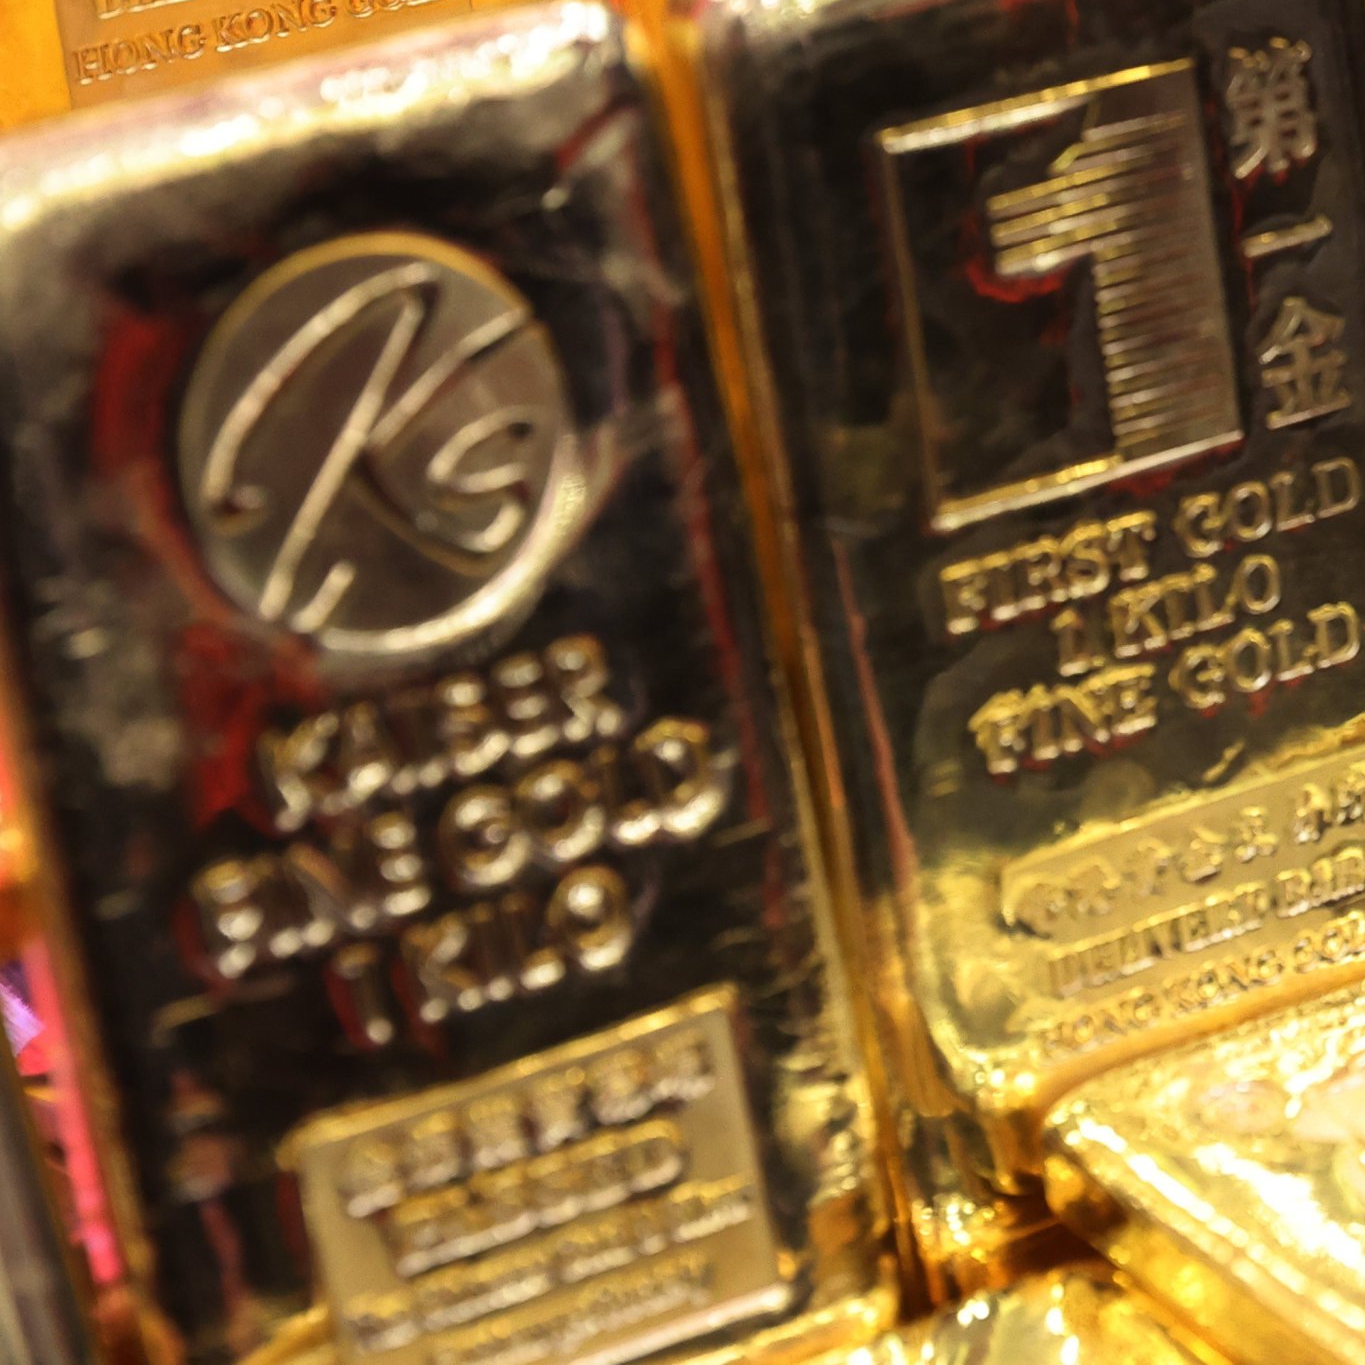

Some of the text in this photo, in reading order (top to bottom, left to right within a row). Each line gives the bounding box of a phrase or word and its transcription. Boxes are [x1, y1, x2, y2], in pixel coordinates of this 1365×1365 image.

[71, 21, 206, 86] HONG
[940, 457, 1362, 634] FIRST GOLD
[1051, 554, 1281, 678] 1 KILO
[258, 634, 622, 833] KAISER
[970, 601, 1362, 775] FINE GOLD
[193, 715, 735, 980] FINE GOLD
[332, 866, 637, 1045] 1 KILO
